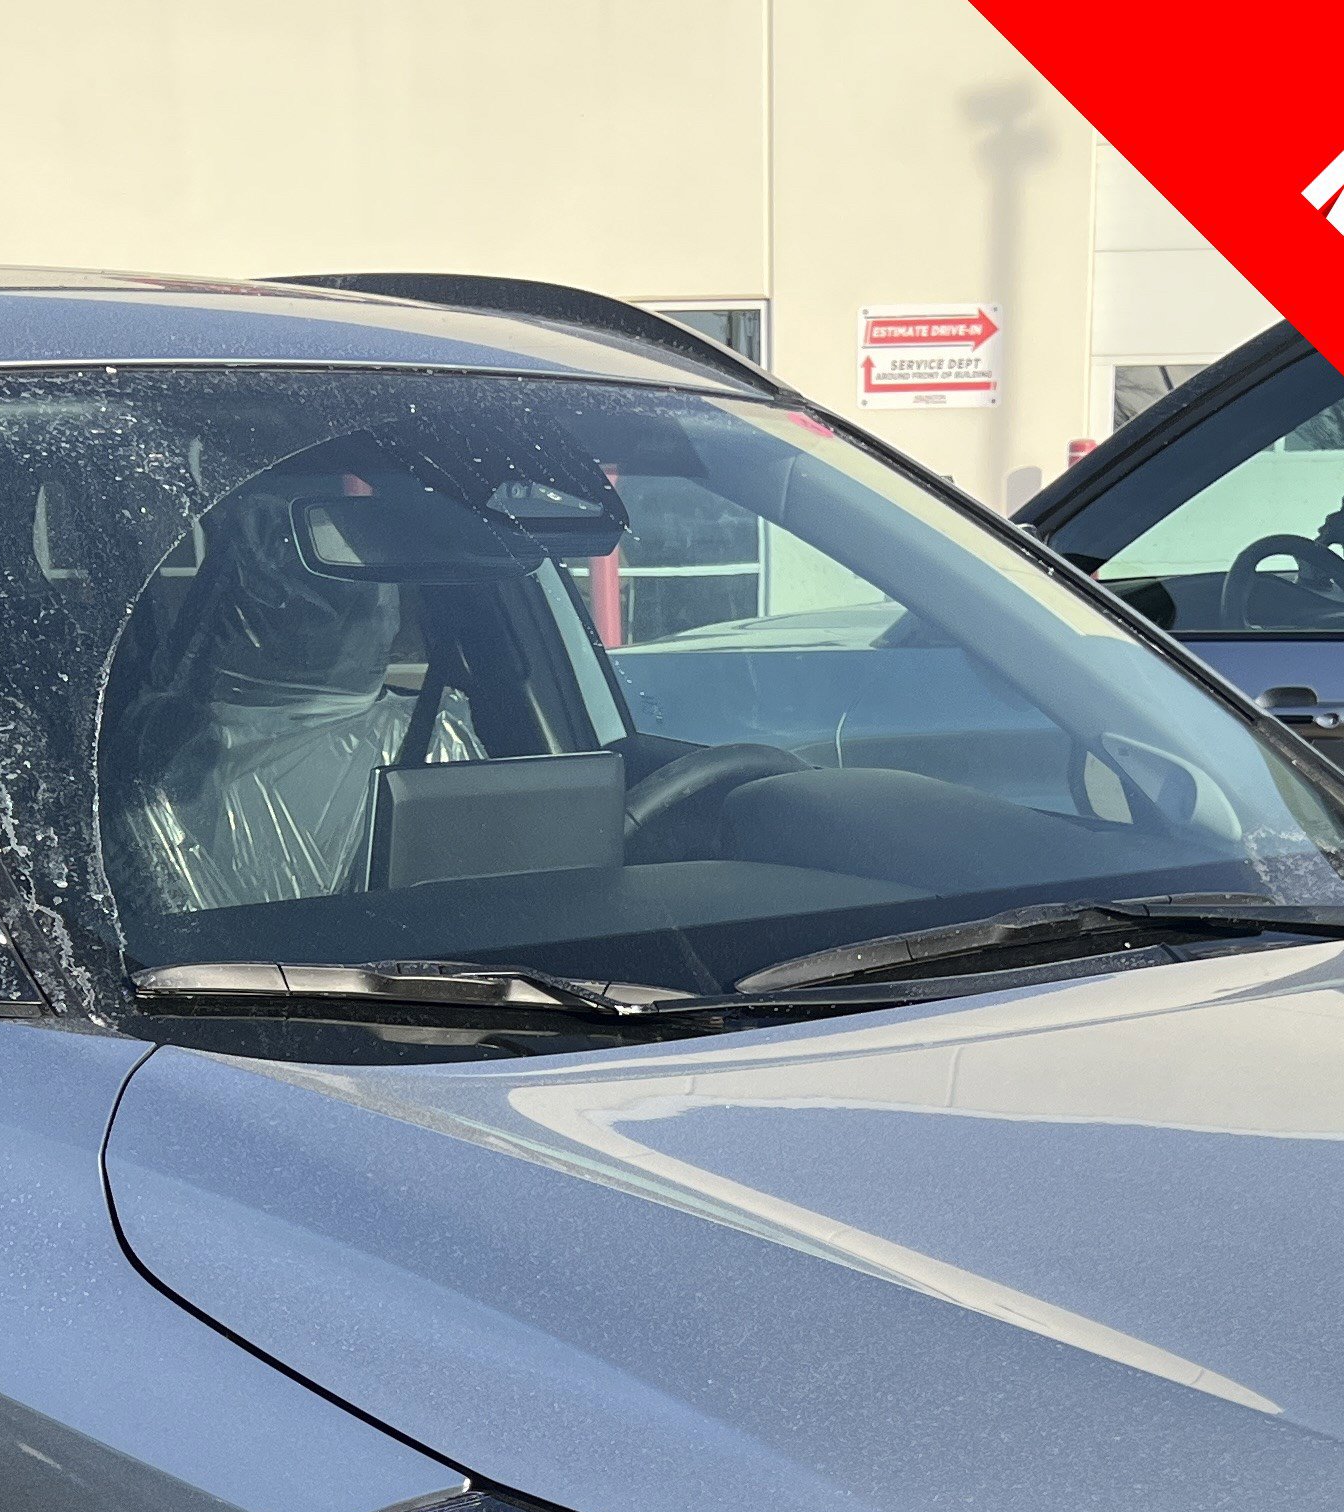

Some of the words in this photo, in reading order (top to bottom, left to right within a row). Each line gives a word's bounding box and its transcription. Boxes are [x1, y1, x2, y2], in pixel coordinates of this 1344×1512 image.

[872, 325, 929, 338] ESTIMATE
[930, 324, 983, 337] DRIVE-IN
[890, 359, 945, 371] SERVICE
[947, 358, 982, 370] DEPT
